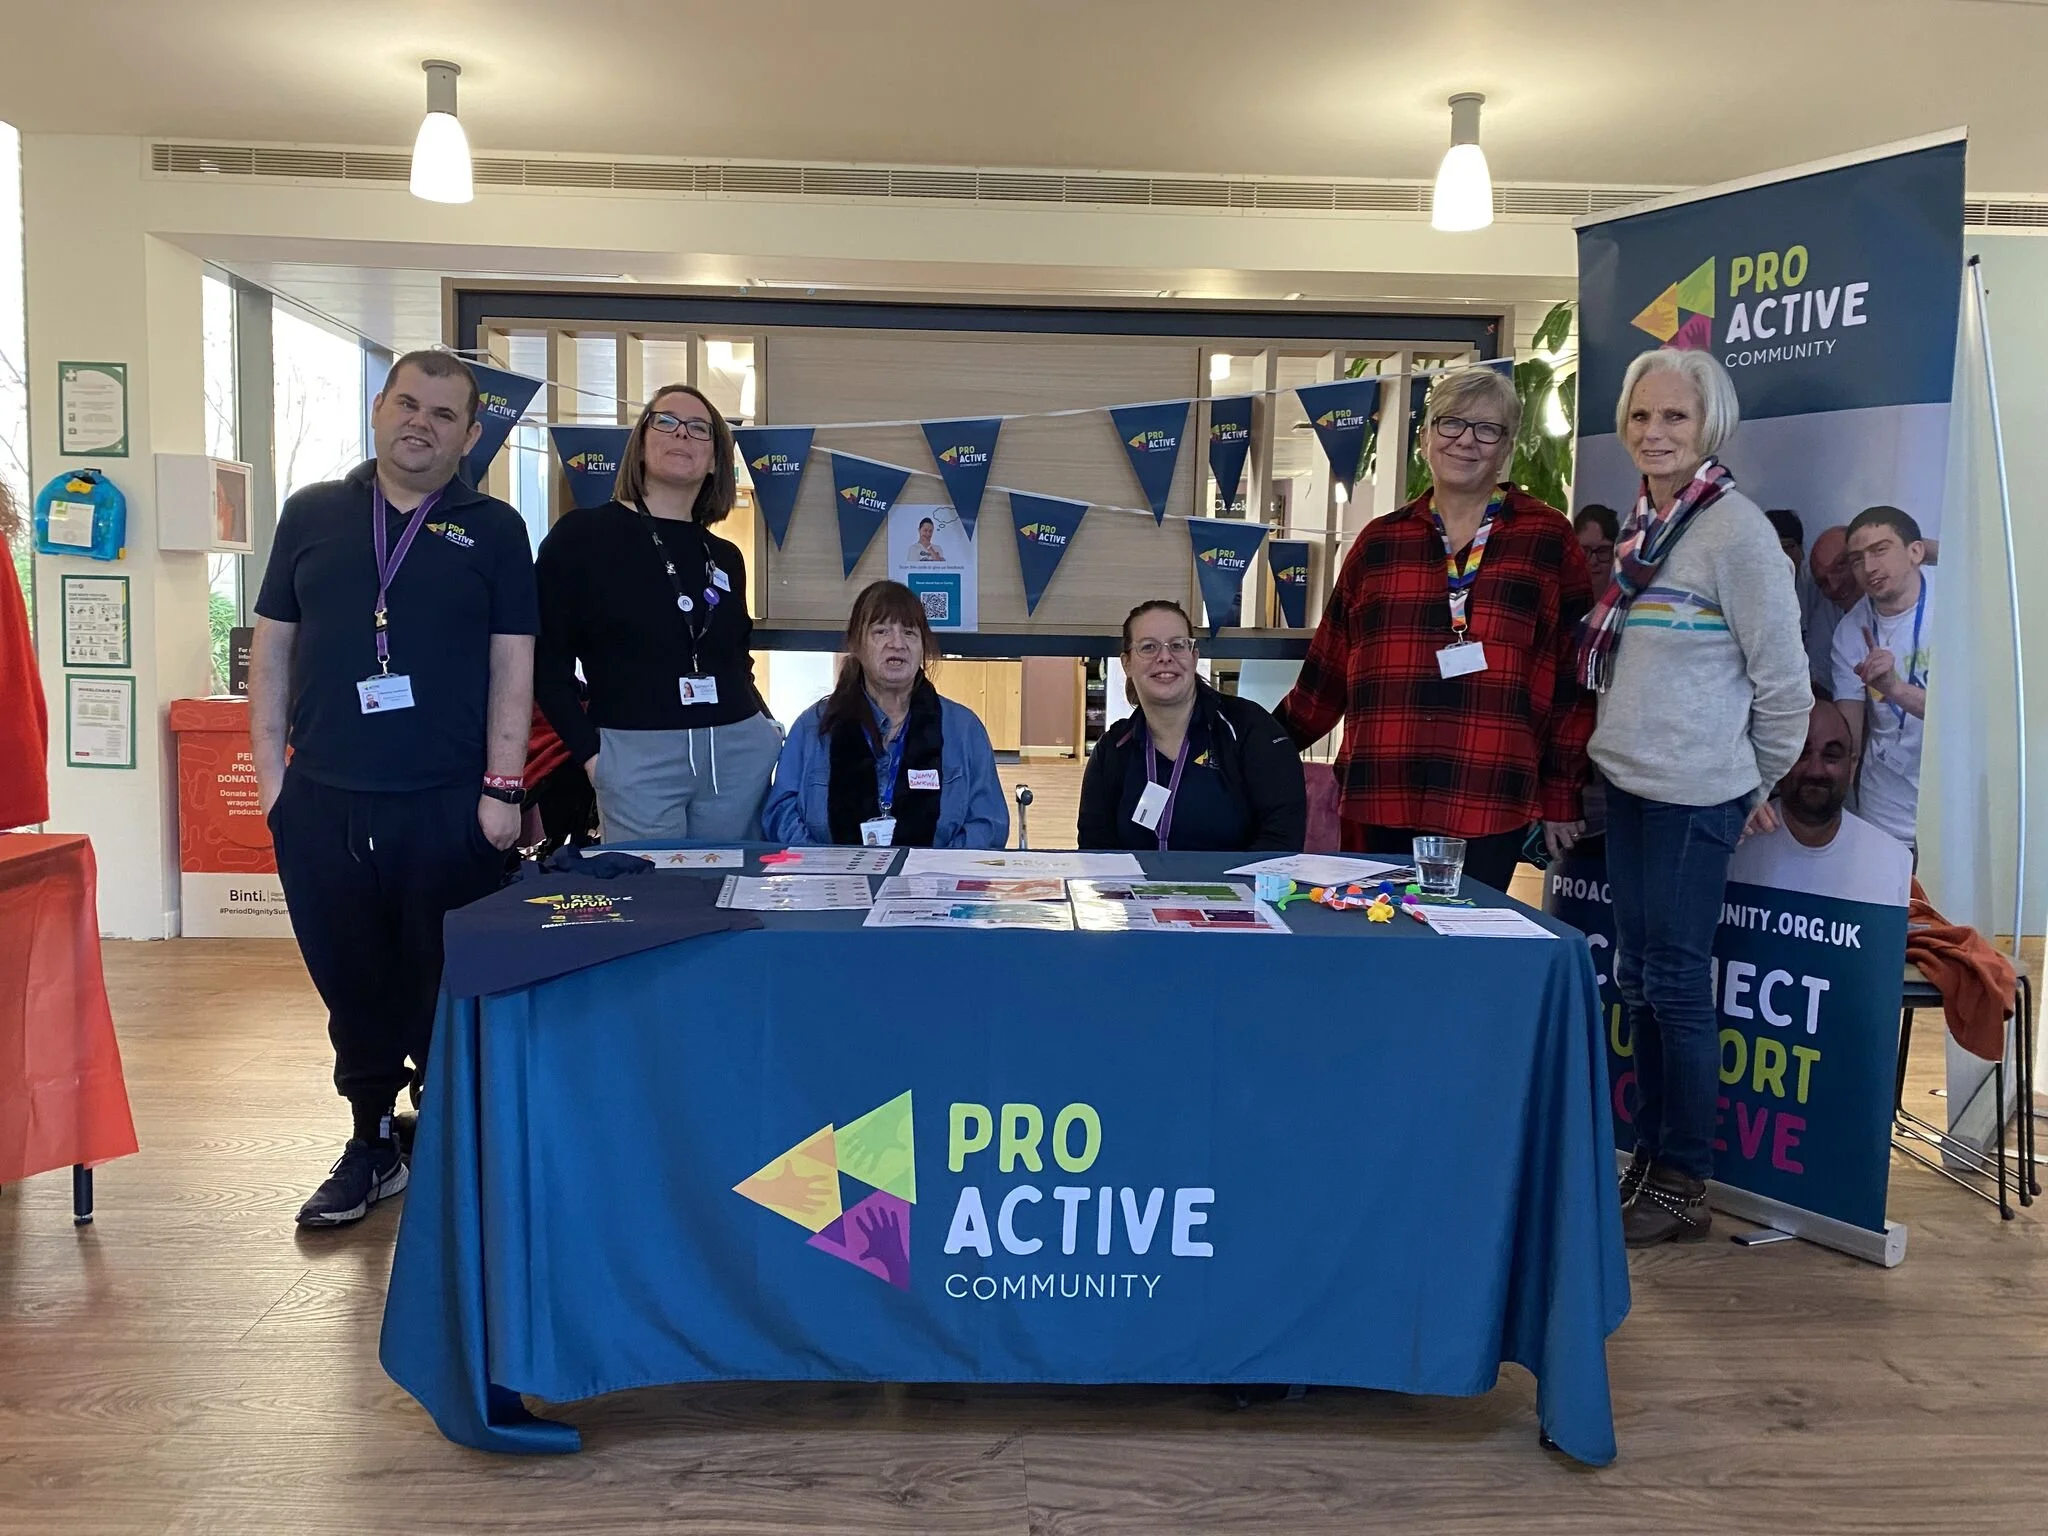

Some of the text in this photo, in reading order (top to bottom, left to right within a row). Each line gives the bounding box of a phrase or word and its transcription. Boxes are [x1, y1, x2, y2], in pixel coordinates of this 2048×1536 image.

[1730, 245, 1808, 297] PRO
[1725, 282, 1869, 343] ACTIVE
[1725, 339, 1837, 367] COMMUNITY
[490, 395, 507, 406] PRO
[487, 403, 517, 418] ACTIVE
[1335, 409, 1351, 418] PRO
[1336, 416, 1364, 427] ACTIVE
[1221, 423, 1237, 431] PRO
[1147, 431, 1164, 439] PRO
[1222, 430, 1248, 440] ACTIVE
[1148, 438, 1176, 448] ACTIVE
[959, 446, 975, 454] PRO
[587, 454, 604, 462] PRO
[771, 454, 787, 463] PRO
[959, 453, 987, 463] ACTIVE
[587, 462, 616, 471] ACTIVE
[772, 462, 800, 471] ACTIVE
[860, 488, 877, 498] PRO
[858, 496, 887, 510] ACTIVE
[447, 523, 465, 535] PRO
[1040, 524, 1056, 534] PRO
[446, 530, 475, 547] ACTIVE
[1038, 533, 1066, 544] ACTIVE
[1219, 549, 1235, 558] PRO
[1217, 557, 1245, 568] ACTIVE
[1295, 574, 1308, 582] AC
[220, 789, 247, 797] Donate
[226, 799, 259, 807] wrapped
[229, 808, 263, 816] products
[230, 889, 266, 901] Binti.
[948, 1103, 1101, 1173] PRO
[944, 1185, 1215, 1257] ACTIVE
[945, 1274, 1161, 1300] COMMUNITY
